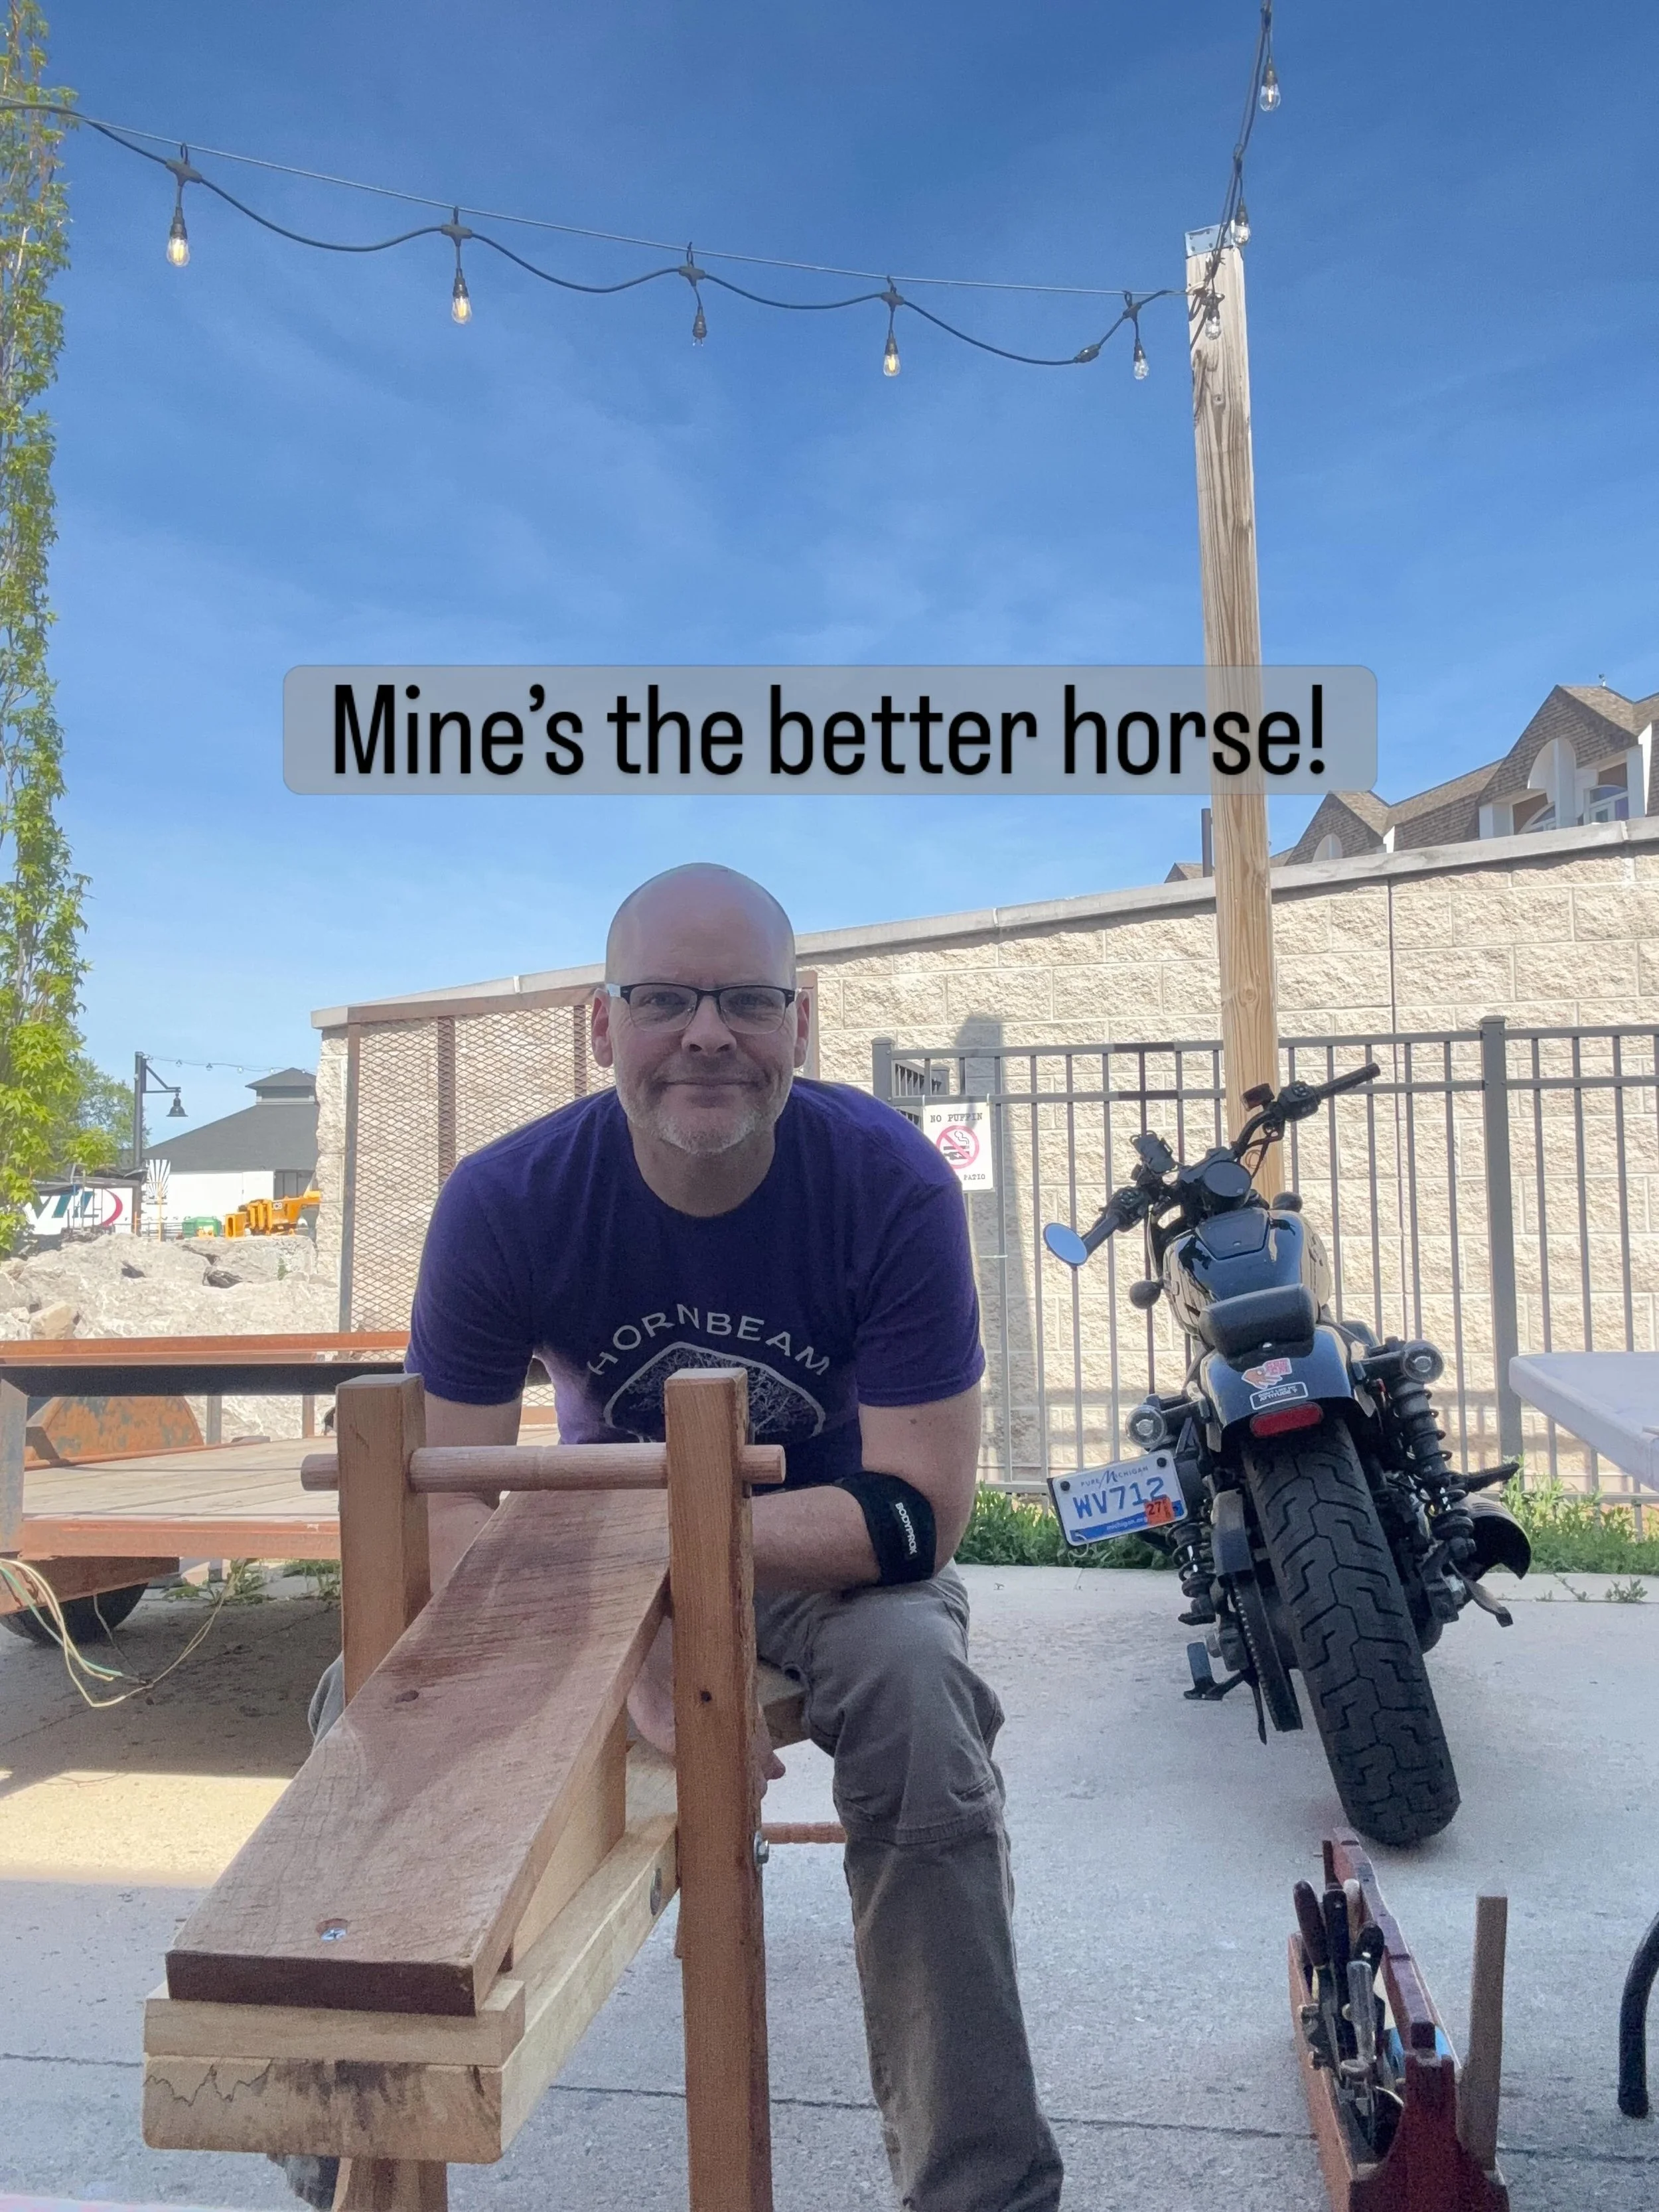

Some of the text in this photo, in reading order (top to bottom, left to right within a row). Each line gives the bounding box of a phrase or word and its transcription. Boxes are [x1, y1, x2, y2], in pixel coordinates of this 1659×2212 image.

[948, 1113, 983, 1122] PUFFIN
[586, 1303, 830, 1376] HORNBEAM
[1080, 1465, 1149, 1489] PURE MICHIGAN
[1073, 1476, 1167, 1519] WV712
[1147, 1501, 1161, 1515] 27
[895, 1502, 919, 1555] BODYPROX
